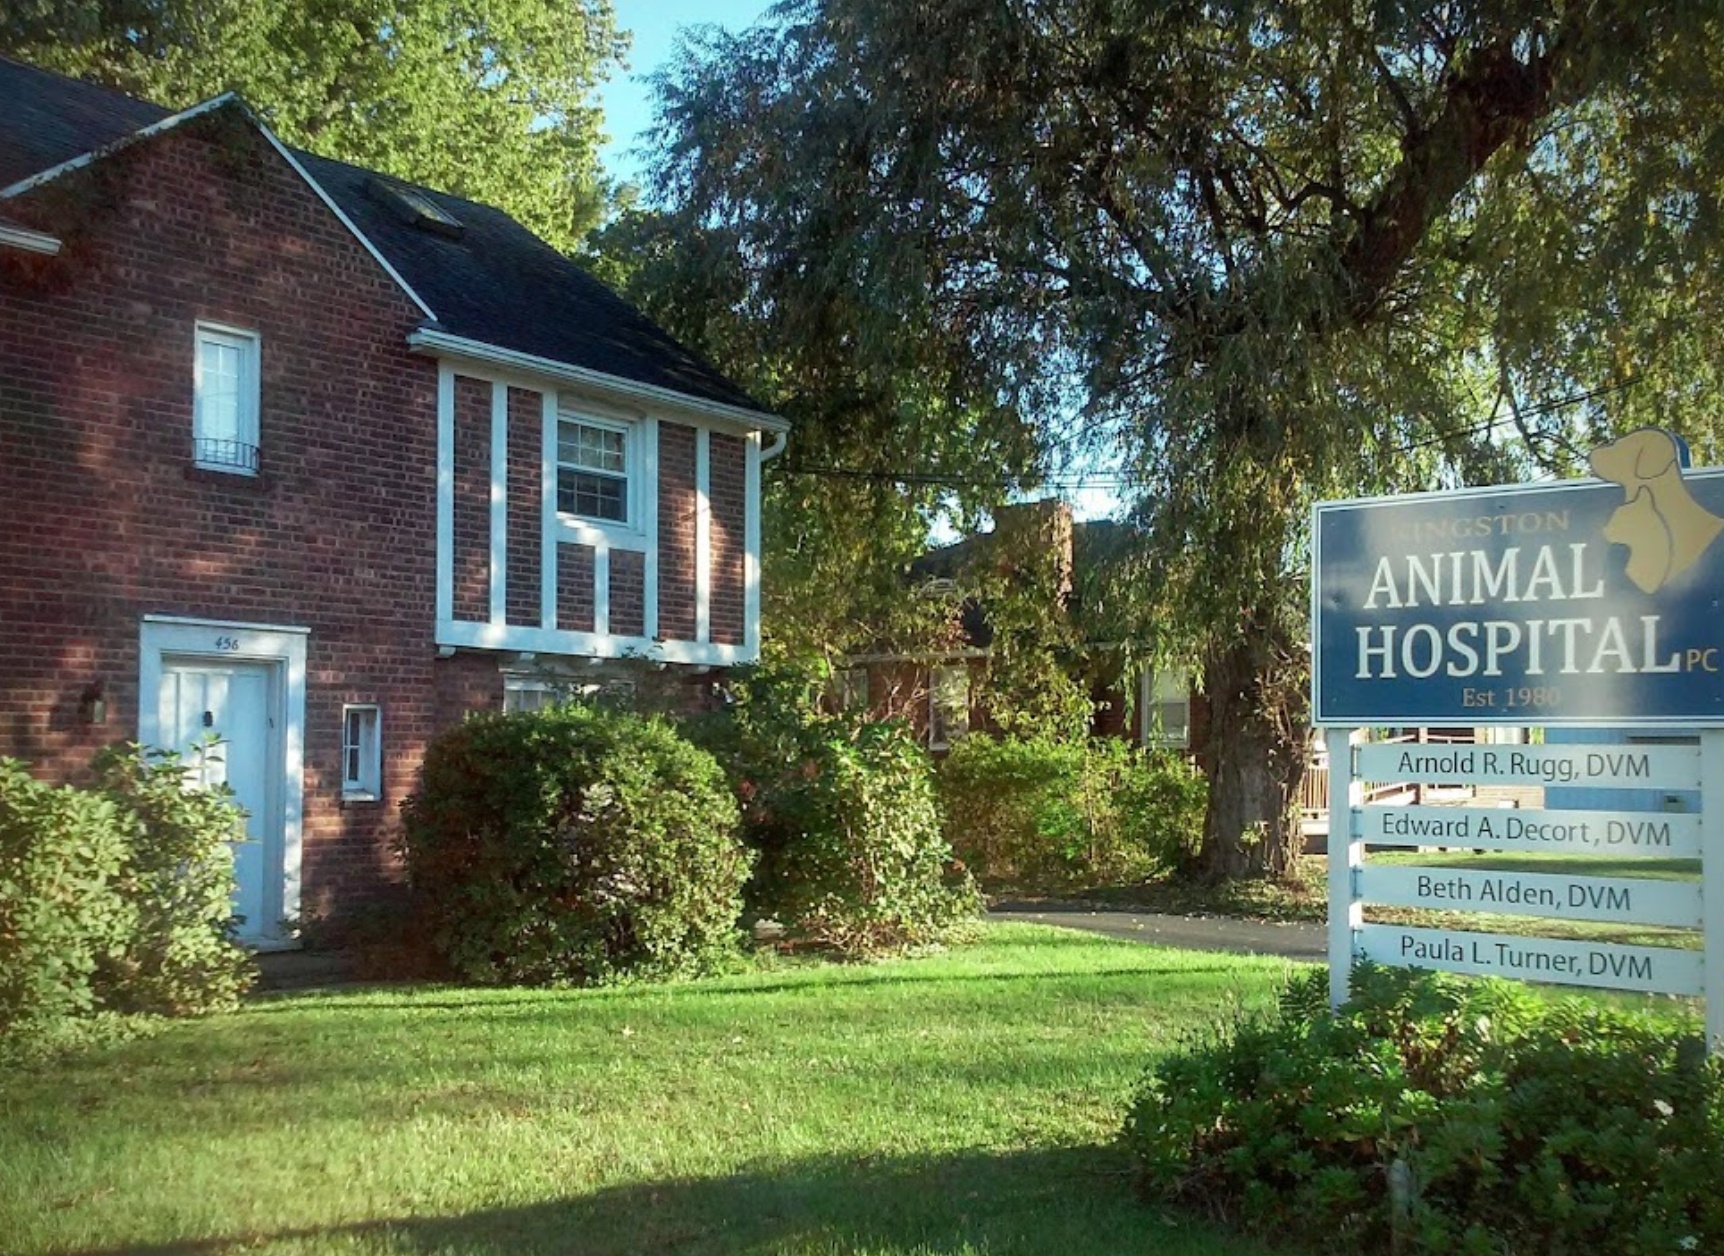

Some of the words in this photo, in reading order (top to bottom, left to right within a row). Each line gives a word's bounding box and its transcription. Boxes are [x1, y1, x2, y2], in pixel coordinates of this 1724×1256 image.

[1363, 543, 1604, 609] ANIMAL
[215, 635, 240, 651] 456
[1355, 615, 1680, 679] HOSPITAL
[1687, 649, 1718, 672] PC
[1462, 687, 1495, 707] Est
[1505, 686, 1560, 707] 1980
[1398, 752, 1474, 774] Arnold
[1483, 753, 1504, 775] R.
[1510, 754, 1580, 782] Rugg,
[1586, 754, 1650, 778] DVM
[1382, 813, 1469, 838] Edward
[1477, 816, 1500, 840] A.
[1506, 818, 1600, 847] Decort,
[1607, 821, 1670, 846] DVM
[1418, 876, 1472, 901] Beth
[1480, 879, 1562, 909] Alden,
[1568, 885, 1631, 910] DVM
[1401, 935, 1464, 963] Paula
[1473, 941, 1491, 966] L.
[1495, 943, 1582, 977] Turner,
[1589, 952, 1652, 980] DVM
